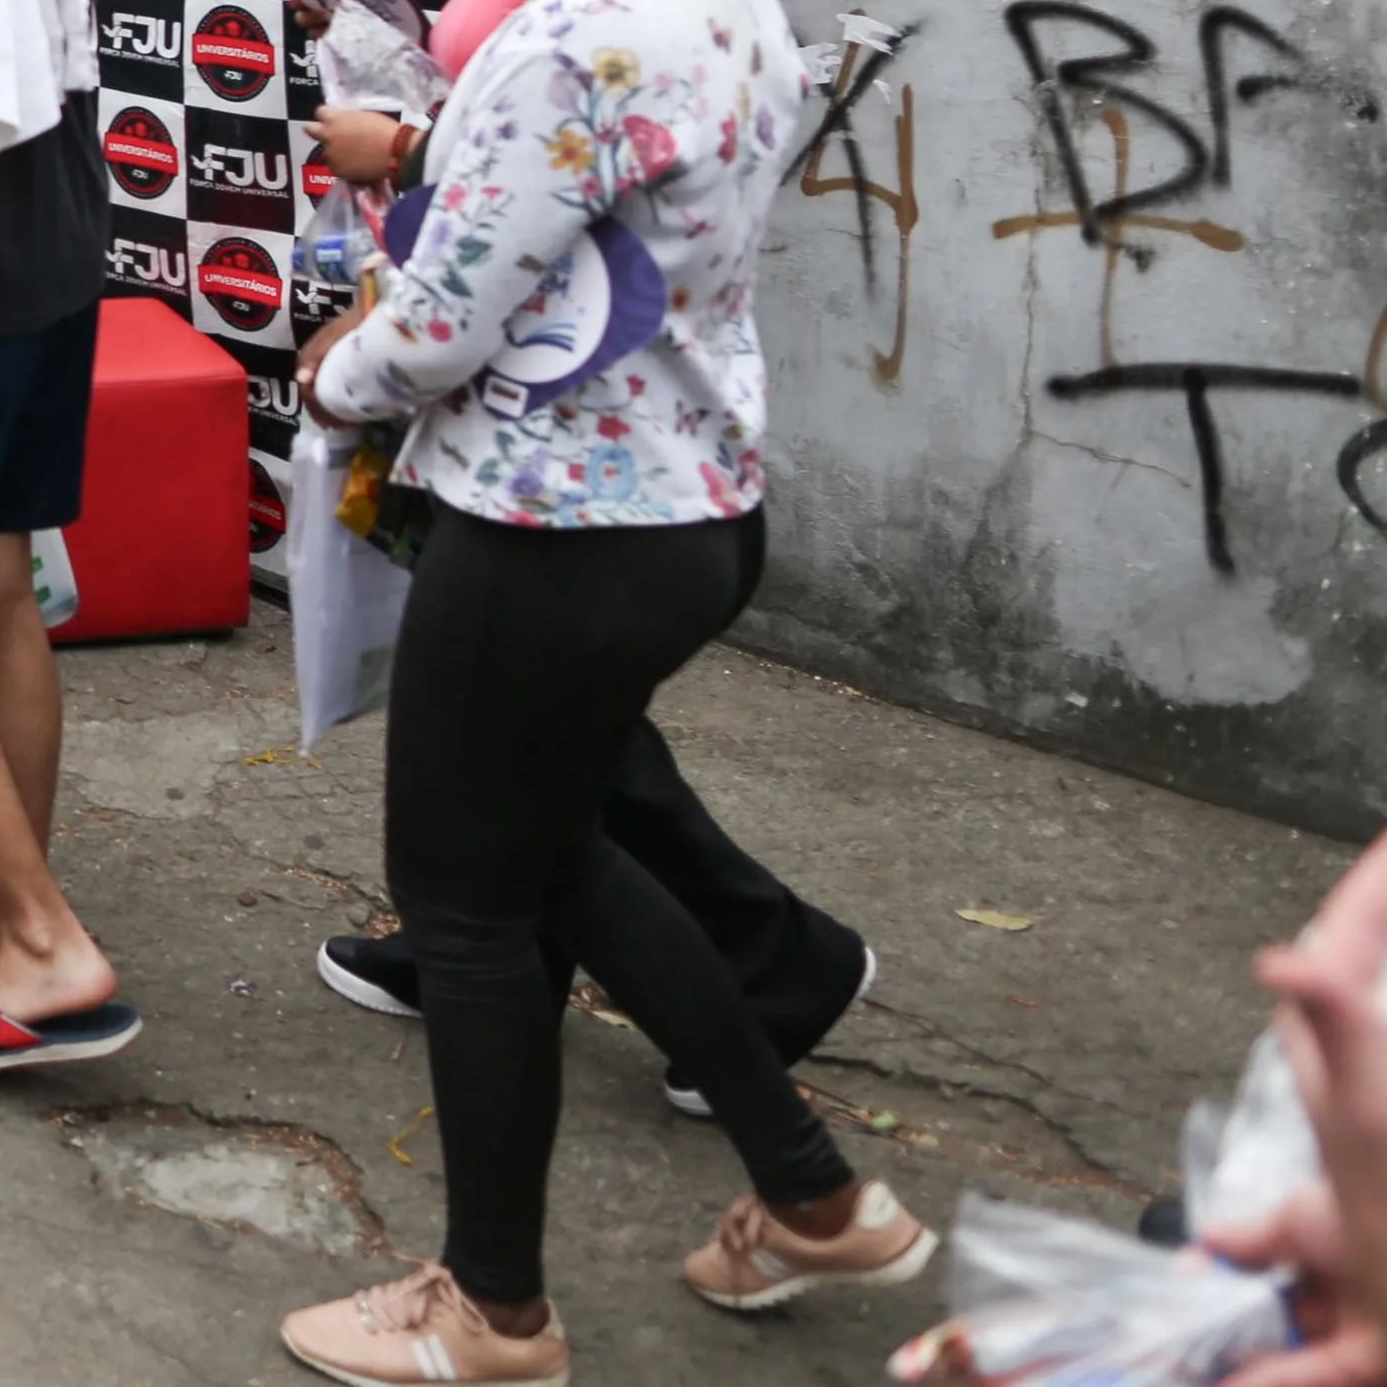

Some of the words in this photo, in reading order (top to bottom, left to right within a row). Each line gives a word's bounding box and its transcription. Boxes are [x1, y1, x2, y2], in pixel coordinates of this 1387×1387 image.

[111, 12, 182, 59] FJU
[204, 143, 288, 190] FJU
[114, 237, 186, 288] FJU
[204, 274, 277, 297] UNIVERSITÁRIOS
